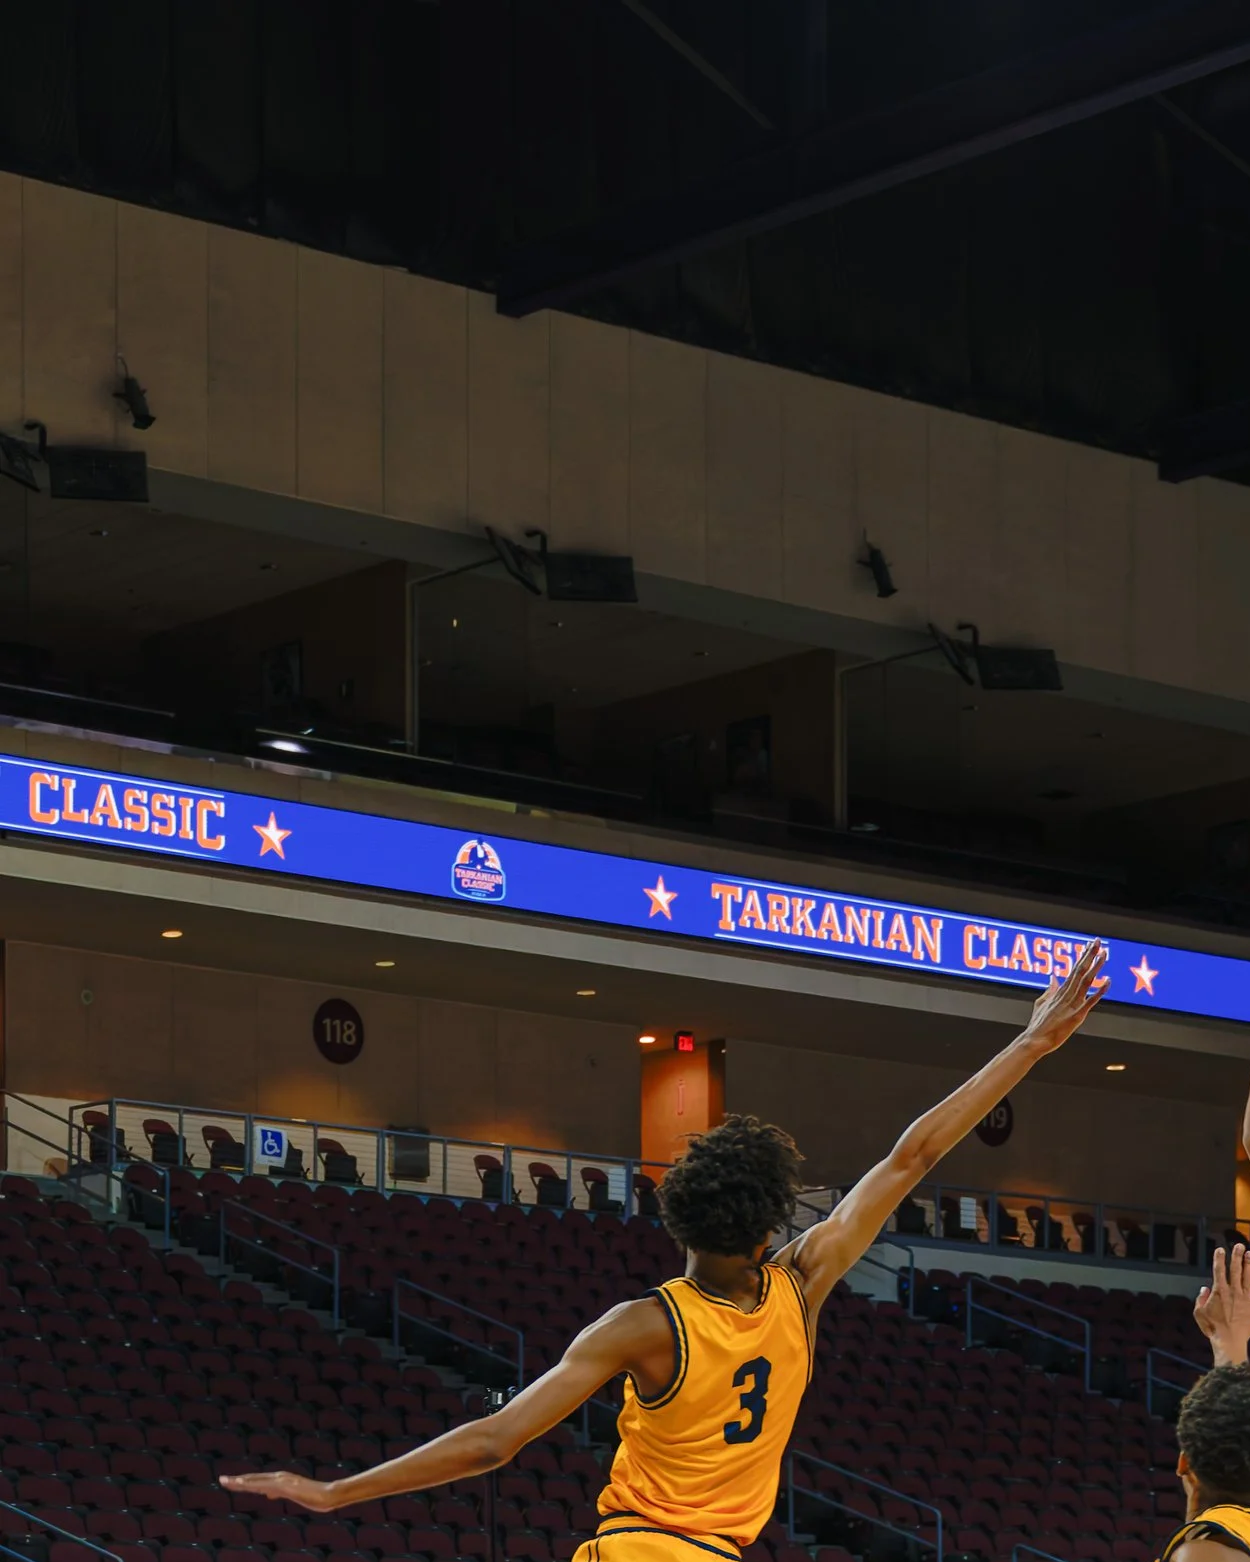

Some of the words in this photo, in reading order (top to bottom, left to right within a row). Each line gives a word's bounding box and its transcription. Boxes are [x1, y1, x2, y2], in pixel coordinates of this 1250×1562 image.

[29, 772, 225, 850] CLASSIC
[711, 883, 943, 964] TARKANIAN
[322, 1018, 356, 1045] 118
[724, 1356, 772, 1445] 3
